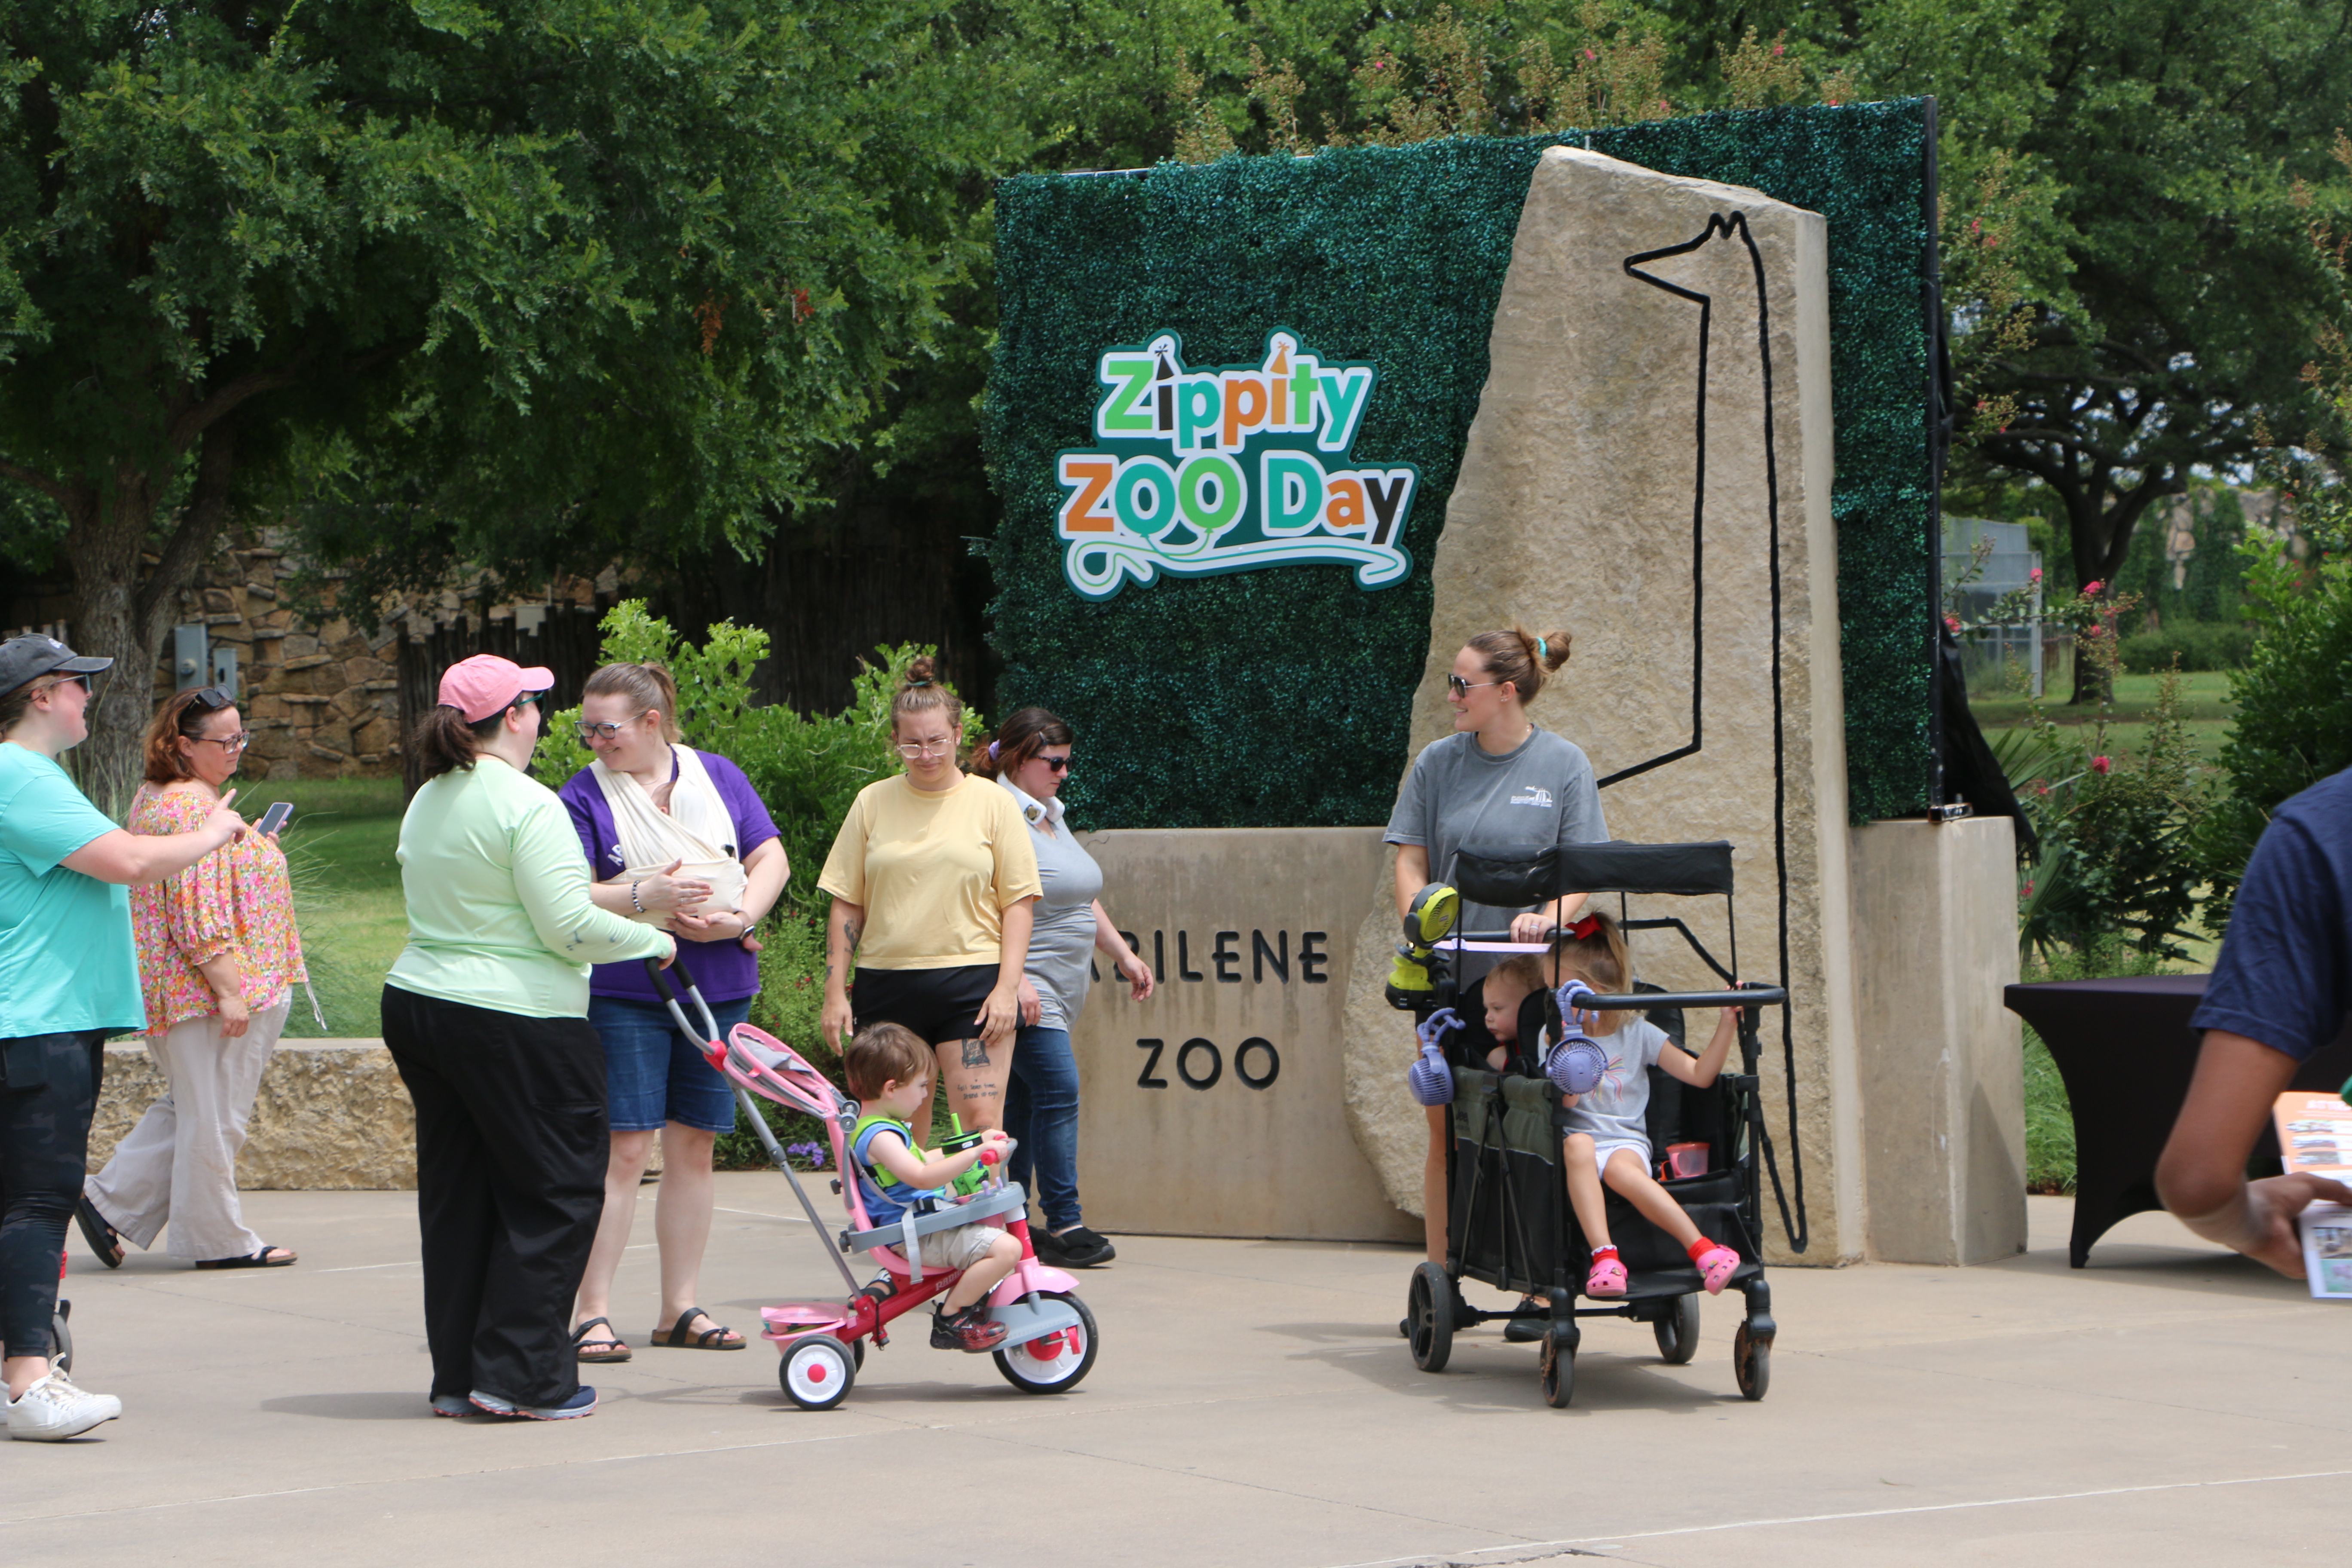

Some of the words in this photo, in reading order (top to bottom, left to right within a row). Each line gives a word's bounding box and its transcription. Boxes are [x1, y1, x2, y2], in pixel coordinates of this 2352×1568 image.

[1105, 342, 1365, 449] Zippity
[1066, 457, 1240, 536] ZOO
[1268, 458, 1407, 544] Day
[1091, 929, 1328, 984] BILENE
[1136, 1037, 1280, 1091] ZOO
